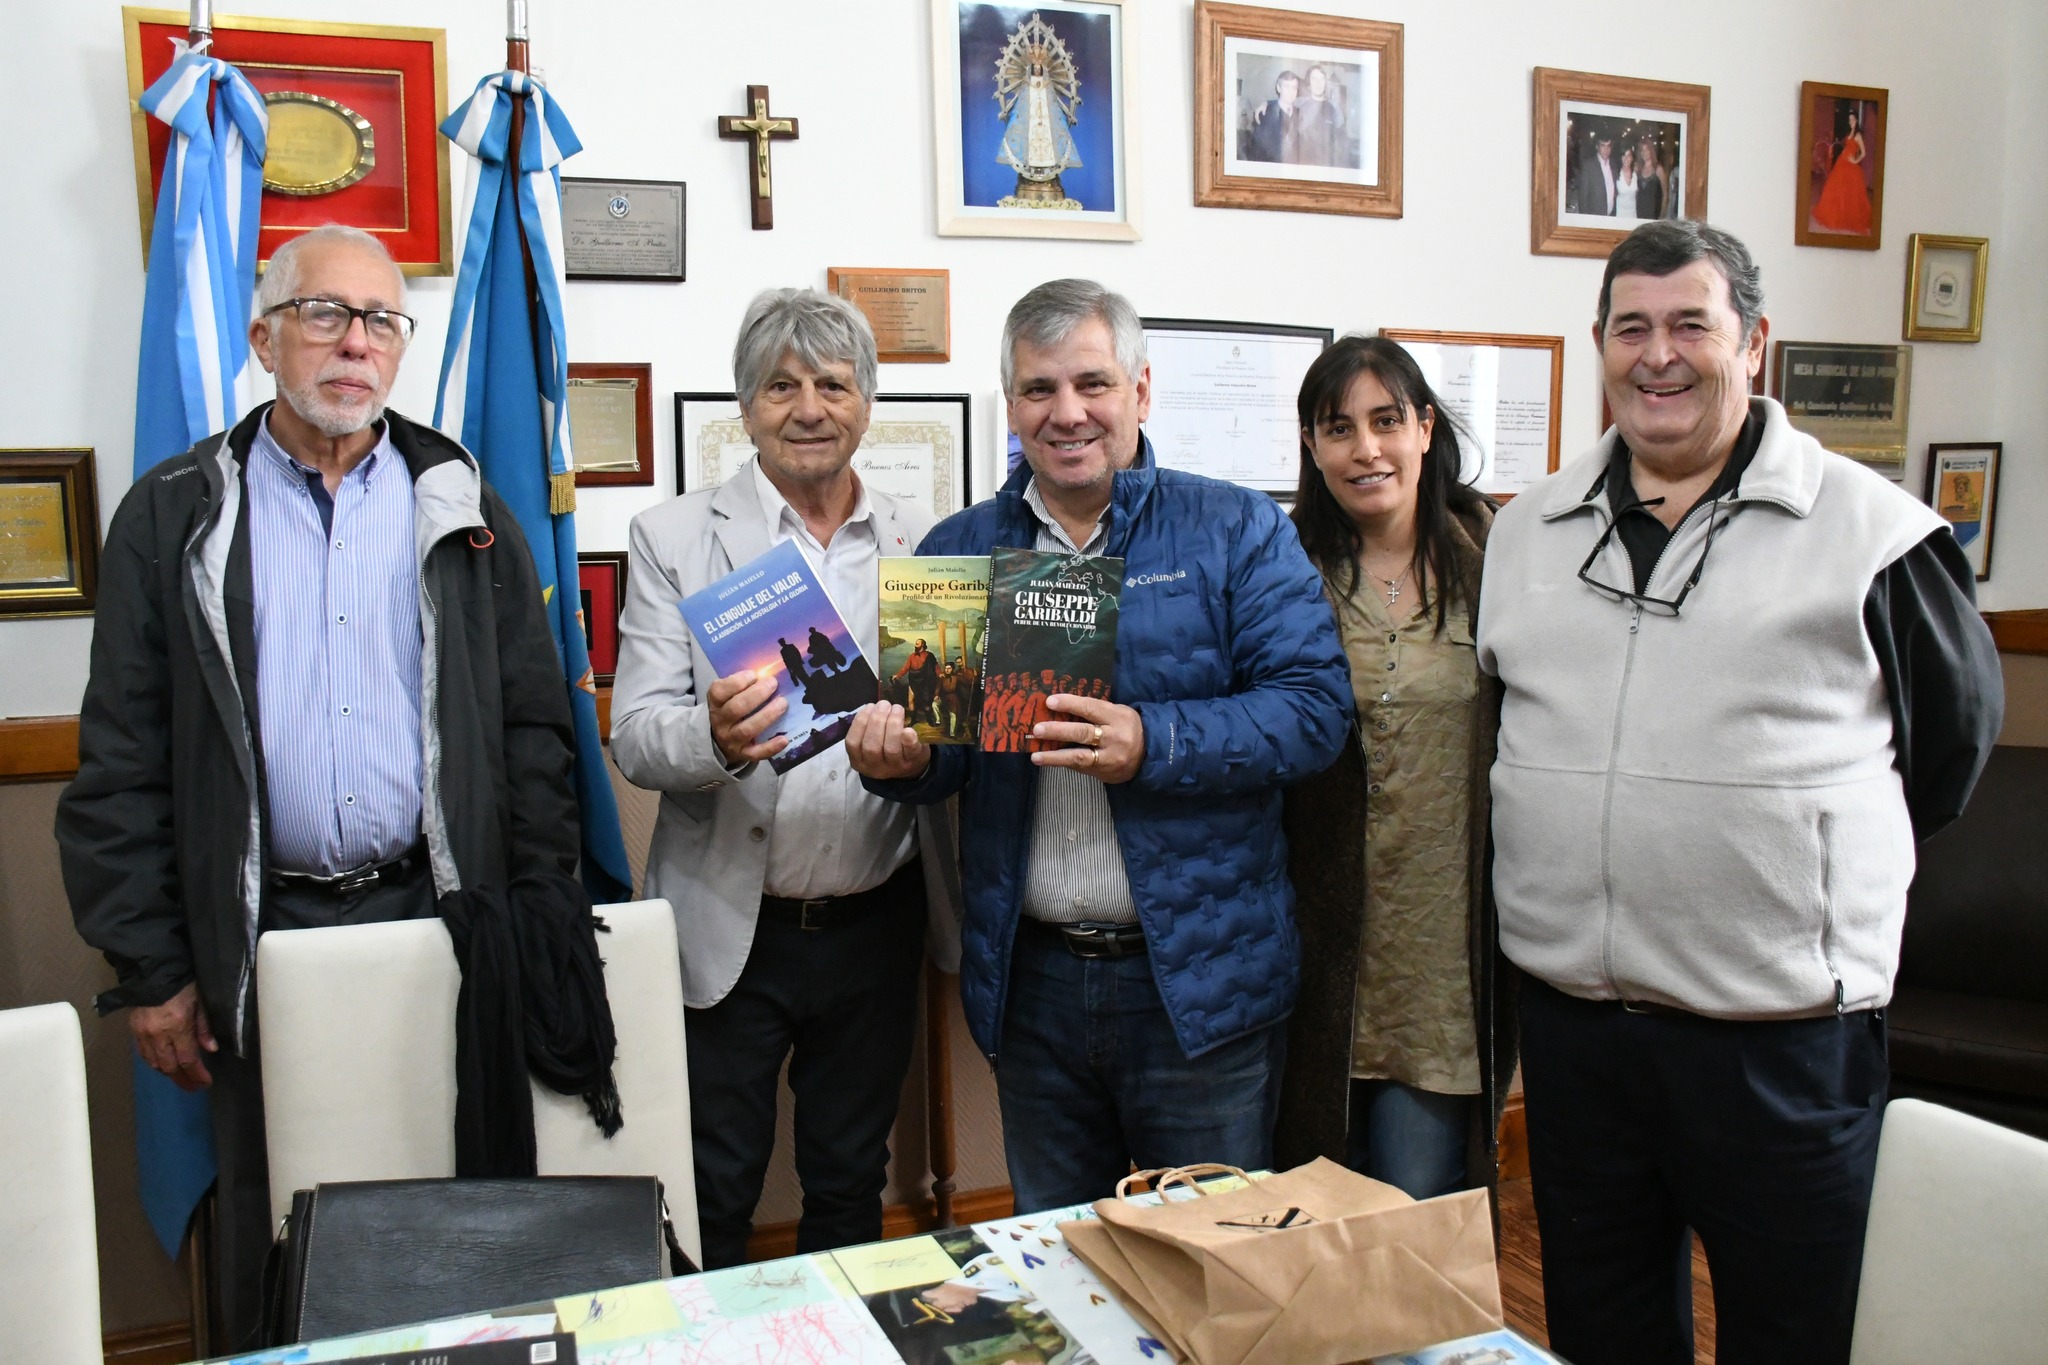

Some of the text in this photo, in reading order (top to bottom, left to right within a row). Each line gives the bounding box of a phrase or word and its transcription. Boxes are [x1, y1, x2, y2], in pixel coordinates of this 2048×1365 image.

[861, 460, 892, 471] Buenos
[894, 460, 920, 471] Aires
[739, 570, 765, 588] MAIELLO
[1030, 579, 1086, 590] JULIÁN MAIELLO
[1137, 569, 1187, 585] Columbia
[885, 580, 945, 594] Giuseppe
[703, 571, 802, 635] EL LENGUAJE DEL VALOR
[751, 601, 779, 620] NOSTALGIA
[789, 584, 809, 599] GLORIA
[1015, 591, 1099, 611] GIUSEPPE
[1014, 606, 1097, 624] GARIBALDI
